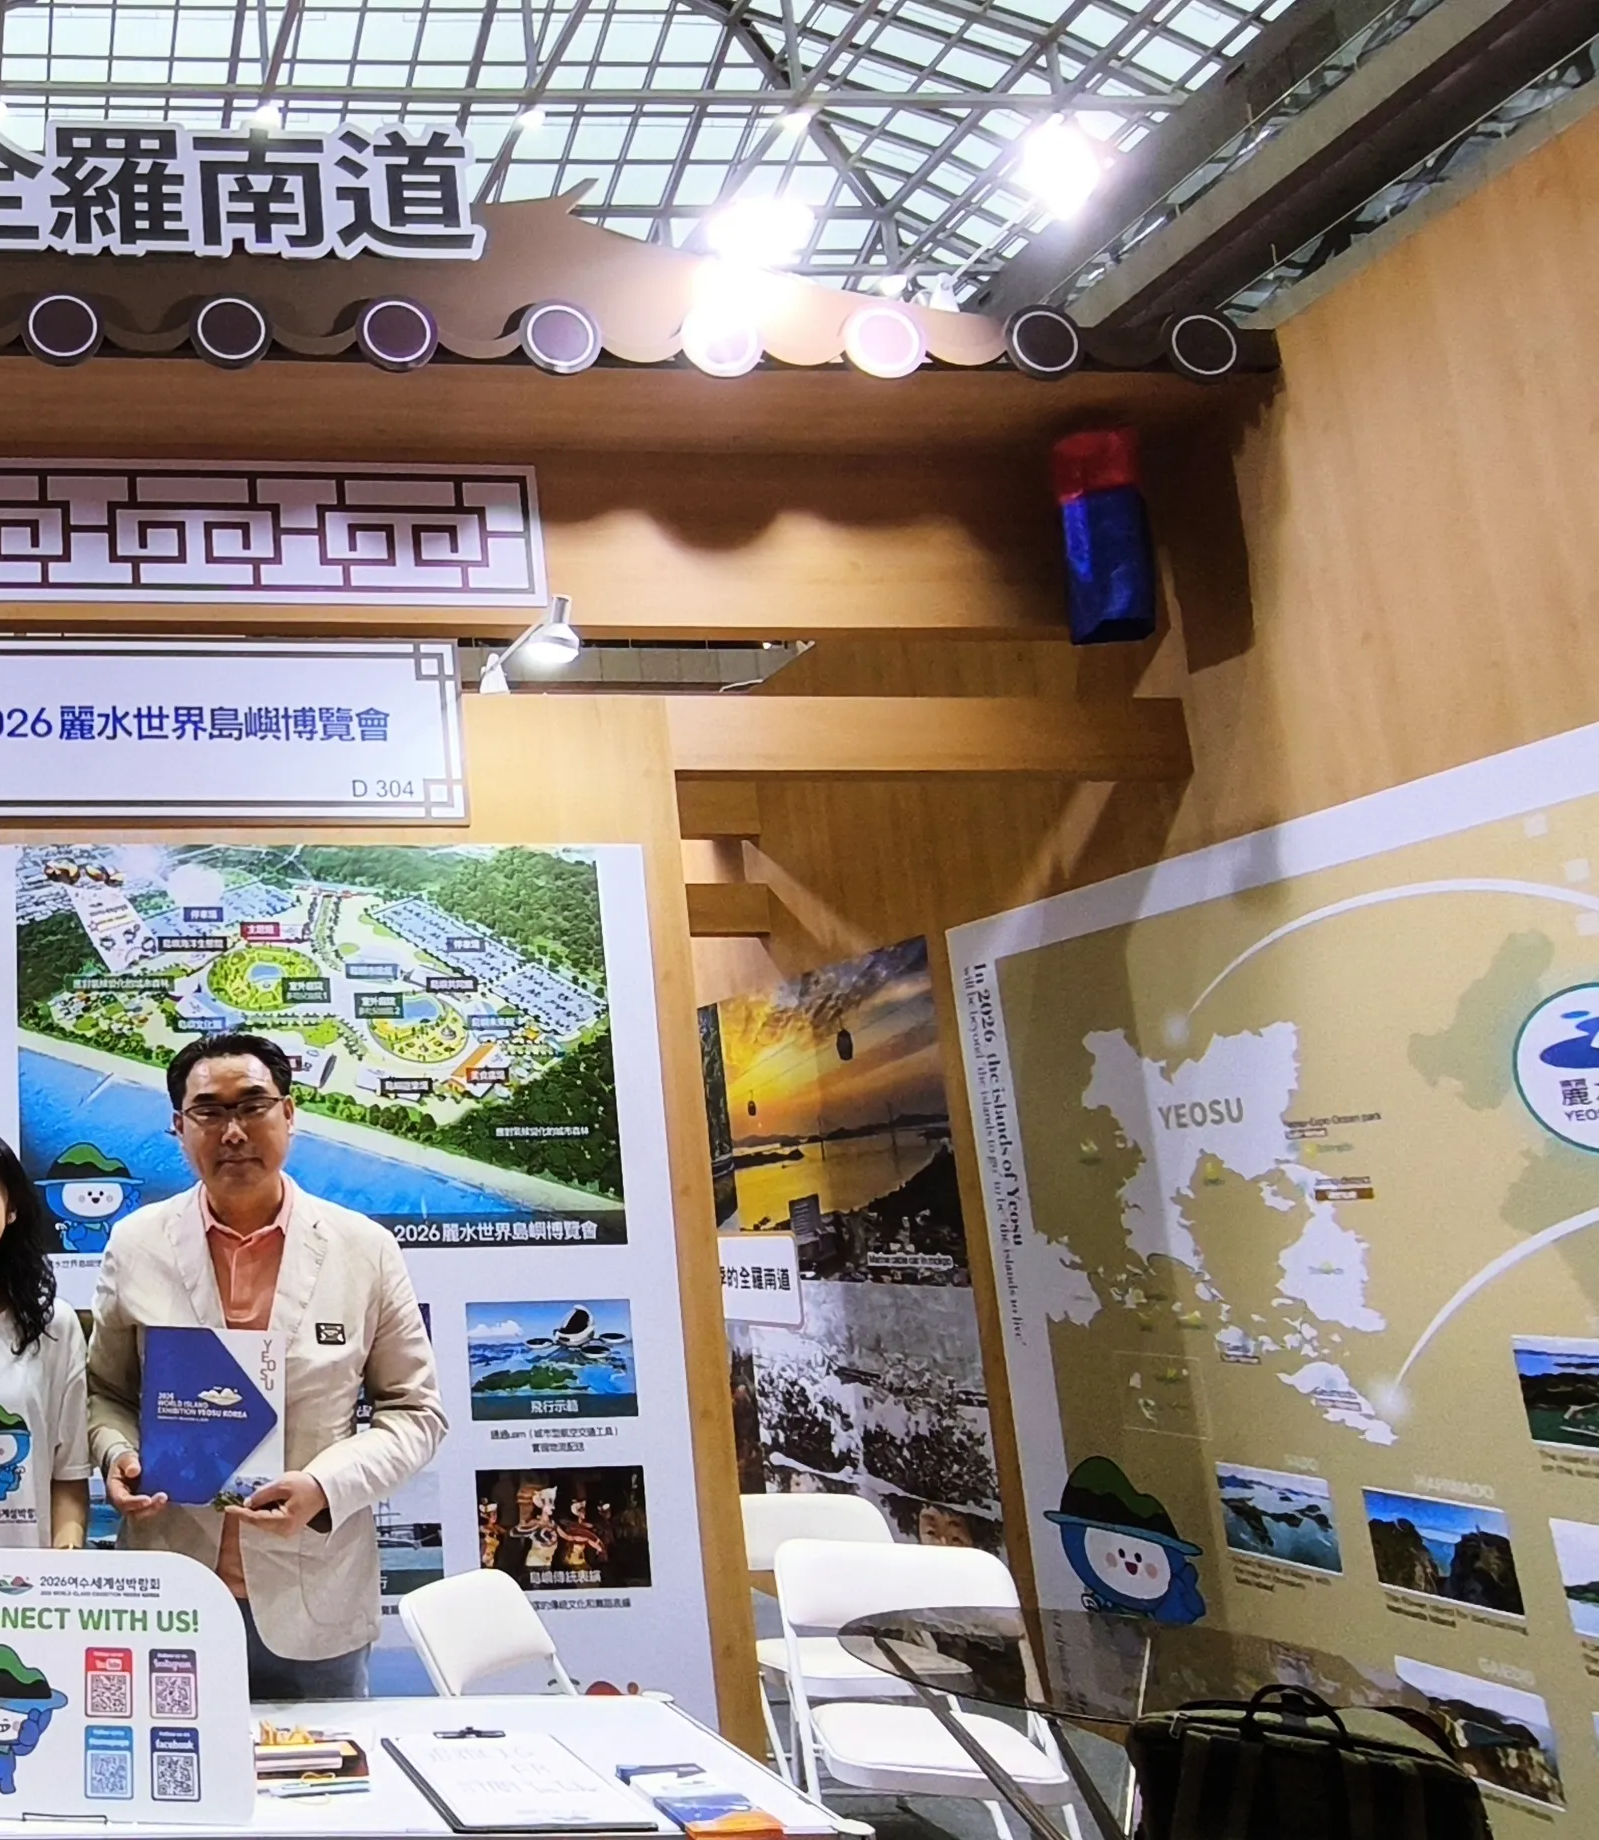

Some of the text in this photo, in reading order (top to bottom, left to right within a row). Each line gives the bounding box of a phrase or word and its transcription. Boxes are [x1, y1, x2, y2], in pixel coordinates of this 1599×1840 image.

[353, 779, 415, 799] D 304
[974, 964, 986, 984] In
[987, 1053, 1001, 1083] the
[1559, 1078, 1599, 1106] 麗
[992, 1087, 1013, 1155] islands
[1158, 1097, 1244, 1130] YEOSU
[1565, 1109, 1599, 1122] YEO
[1002, 1159, 1018, 1181] of
[1007, 1187, 1023, 1245] Yeosu
[78, 1608, 148, 1632] WITH
[156, 1609, 200, 1633] US!
